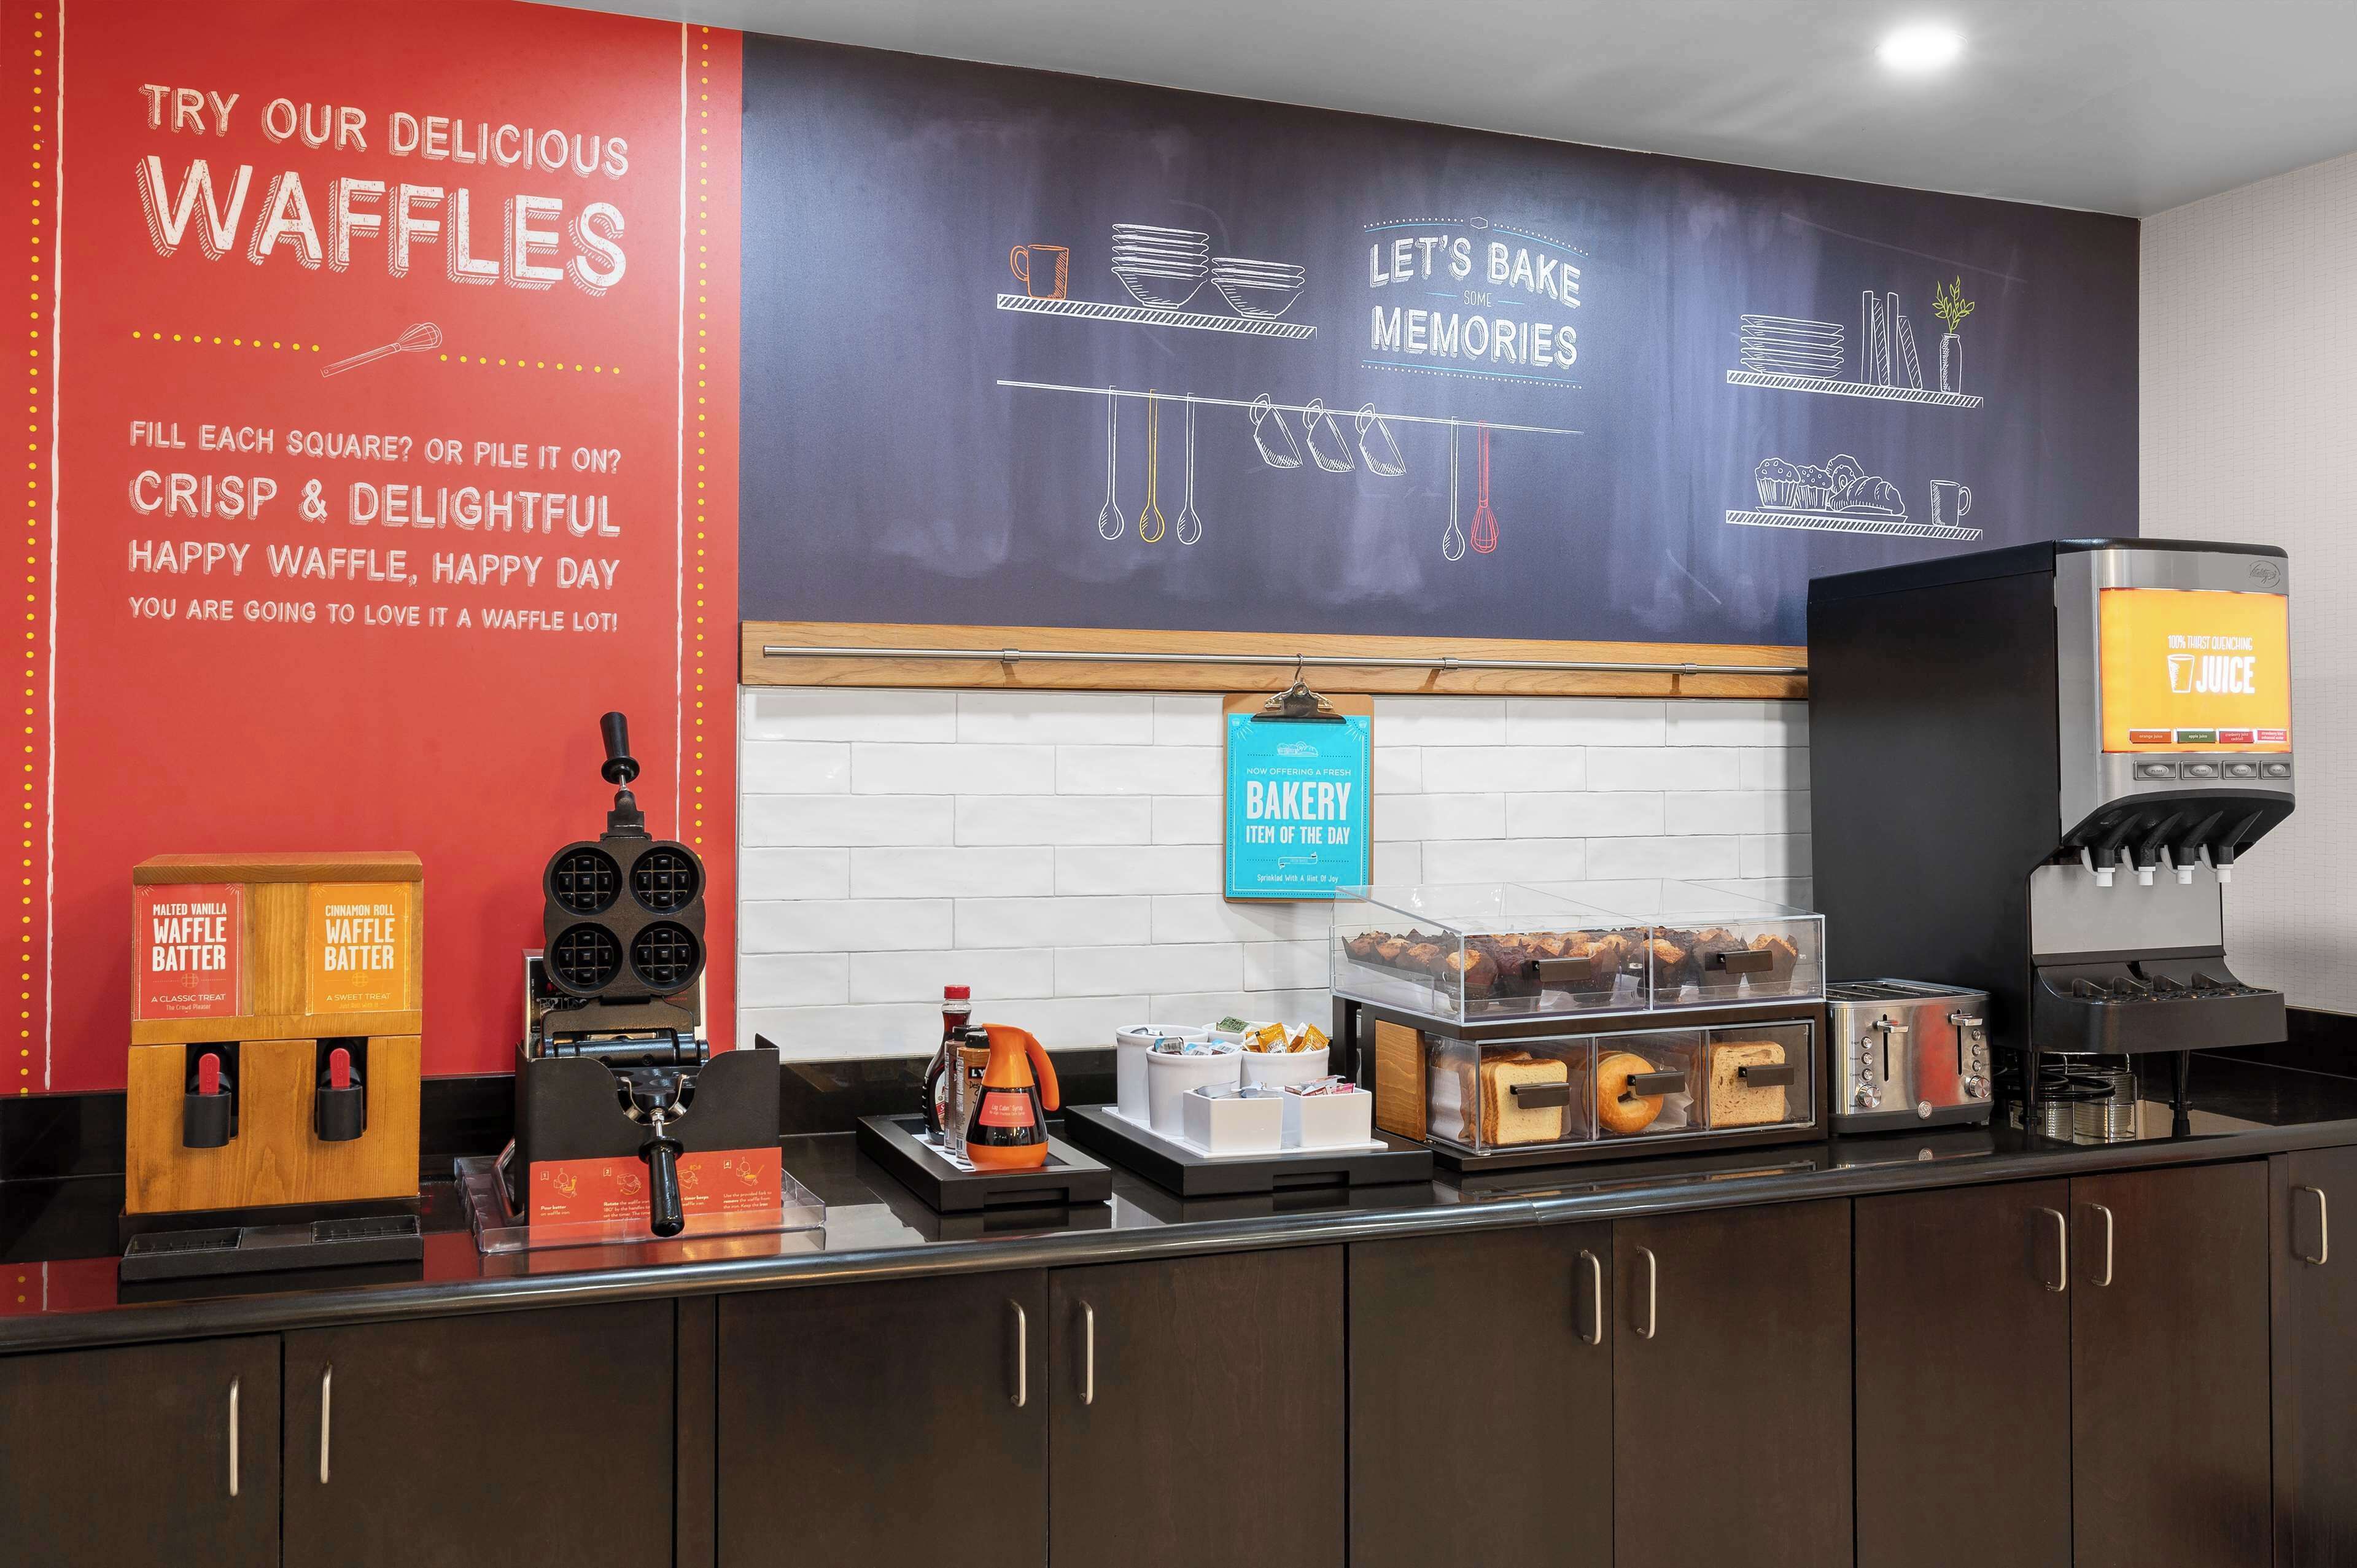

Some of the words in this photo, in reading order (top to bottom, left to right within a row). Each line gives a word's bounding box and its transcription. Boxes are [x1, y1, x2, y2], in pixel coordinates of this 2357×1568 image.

[138, 83, 239, 137] TRY
[261, 98, 367, 152] OUR
[388, 111, 629, 180] DELICIOUS
[136, 155, 626, 297] WAFFLES
[1369, 235, 1472, 289] LET'S
[1486, 241, 1581, 309] BAKE
[1464, 290, 1493, 307] SOME
[1371, 305, 1577, 370] MEMORIES
[130, 421, 186, 449] FILL
[198, 424, 274, 454] EACH
[286, 430, 412, 462] SQUARE?
[424, 438, 462, 465] OR
[473, 442, 527, 469] PILE
[537, 444, 561, 470] IT
[572, 447, 621, 474] ON?
[128, 469, 278, 521] CRISP
[298, 478, 326, 524] &
[348, 481, 621, 538] DELIGHTFUL
[128, 540, 250, 576] HAPPY
[266, 544, 417, 588] WAFFLE,
[432, 552, 543, 586] HAPPY
[556, 556, 620, 590] DAY
[128, 596, 176, 621] YOU
[186, 597, 234, 621] ARE
[243, 599, 316, 624] GOING
[328, 602, 355, 625] TO
[364, 604, 421, 628] LOVE
[429, 605, 448, 628] IT
[456, 607, 472, 629] A
[481, 608, 565, 631] WAFFLE
[572, 611, 618, 632] LOT!
[2167, 635, 2186, 649] 100%
[2187, 635, 2210, 650] THIRST
[2211, 635, 2253, 651] QUENCHING
[2196, 655, 2255, 694] JUICE
[1270, 767, 1313, 776] OFFERING
[1247, 781, 1351, 820] BAKERY
[1246, 826, 1275, 844] ITEM
[1280, 826, 1295, 844] OF
[1300, 826, 1322, 845] THE
[1328, 827, 1350, 845] DAY
[1257, 874, 1283, 883] Sprinkled
[1328, 875, 1338, 884] Joy
[153, 903, 188, 915] MALTED
[191, 902, 227, 915] VANILLA
[325, 904, 370, 917] CINNAMON
[373, 904, 395, 916] ROLL
[153, 917, 227, 944] WAFFLE
[325, 917, 395, 944] WAFFLE
[152, 945, 226, 971] BATTER
[324, 945, 394, 971] BATTER
